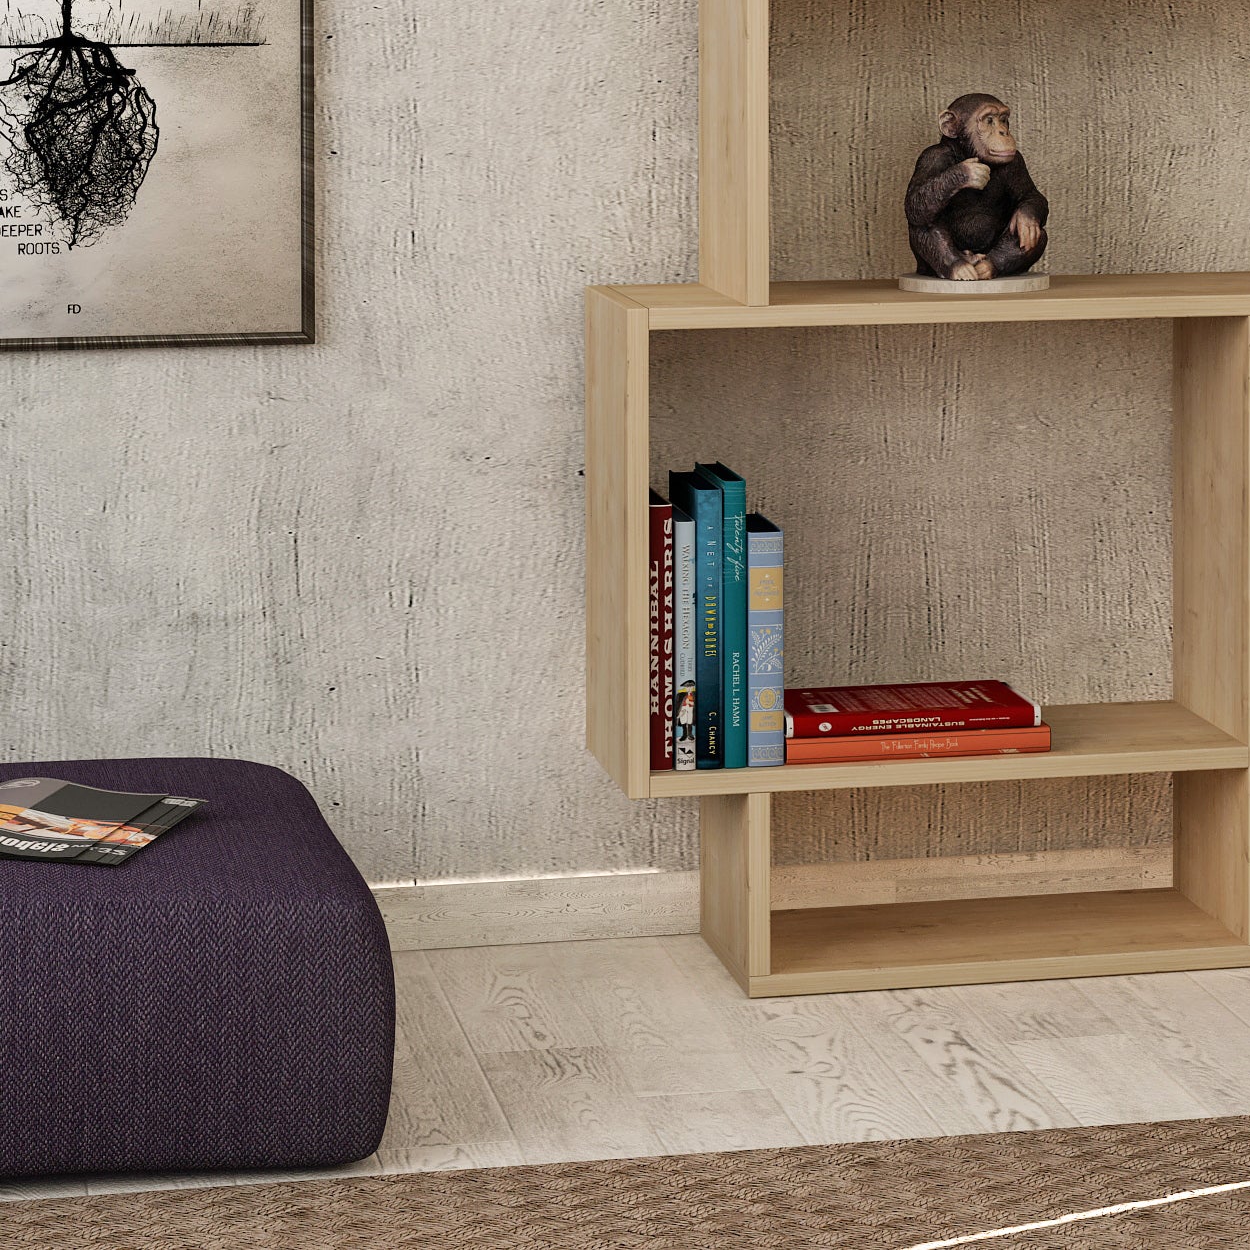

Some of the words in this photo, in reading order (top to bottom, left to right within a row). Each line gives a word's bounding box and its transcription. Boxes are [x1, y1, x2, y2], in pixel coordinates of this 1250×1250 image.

[0, 224, 43, 237] EEPER
[18, 242, 62, 255] ROOTS.
[68, 304, 82, 314] FD
[682, 544, 690, 587] WALKING
[707, 541, 716, 566] NET
[664, 518, 672, 634] HARRIS
[682, 588, 690, 605] THE
[704, 596, 716, 622] DAWN
[650, 561, 659, 716] HANNIBAL
[682, 606, 690, 650] HEXAGON
[705, 631, 717, 658] BONES
[732, 652, 740, 688] RACHEL
[664, 637, 672, 758] THOMAS
[708, 712, 716, 721] C.
[732, 698, 740, 728] HAMM
[872, 716, 941, 724] LANDSCAPES
[895, 721, 964, 729] SUSTAINABLE
[708, 726, 717, 754] CHANCY
[880, 741, 890, 750] The
